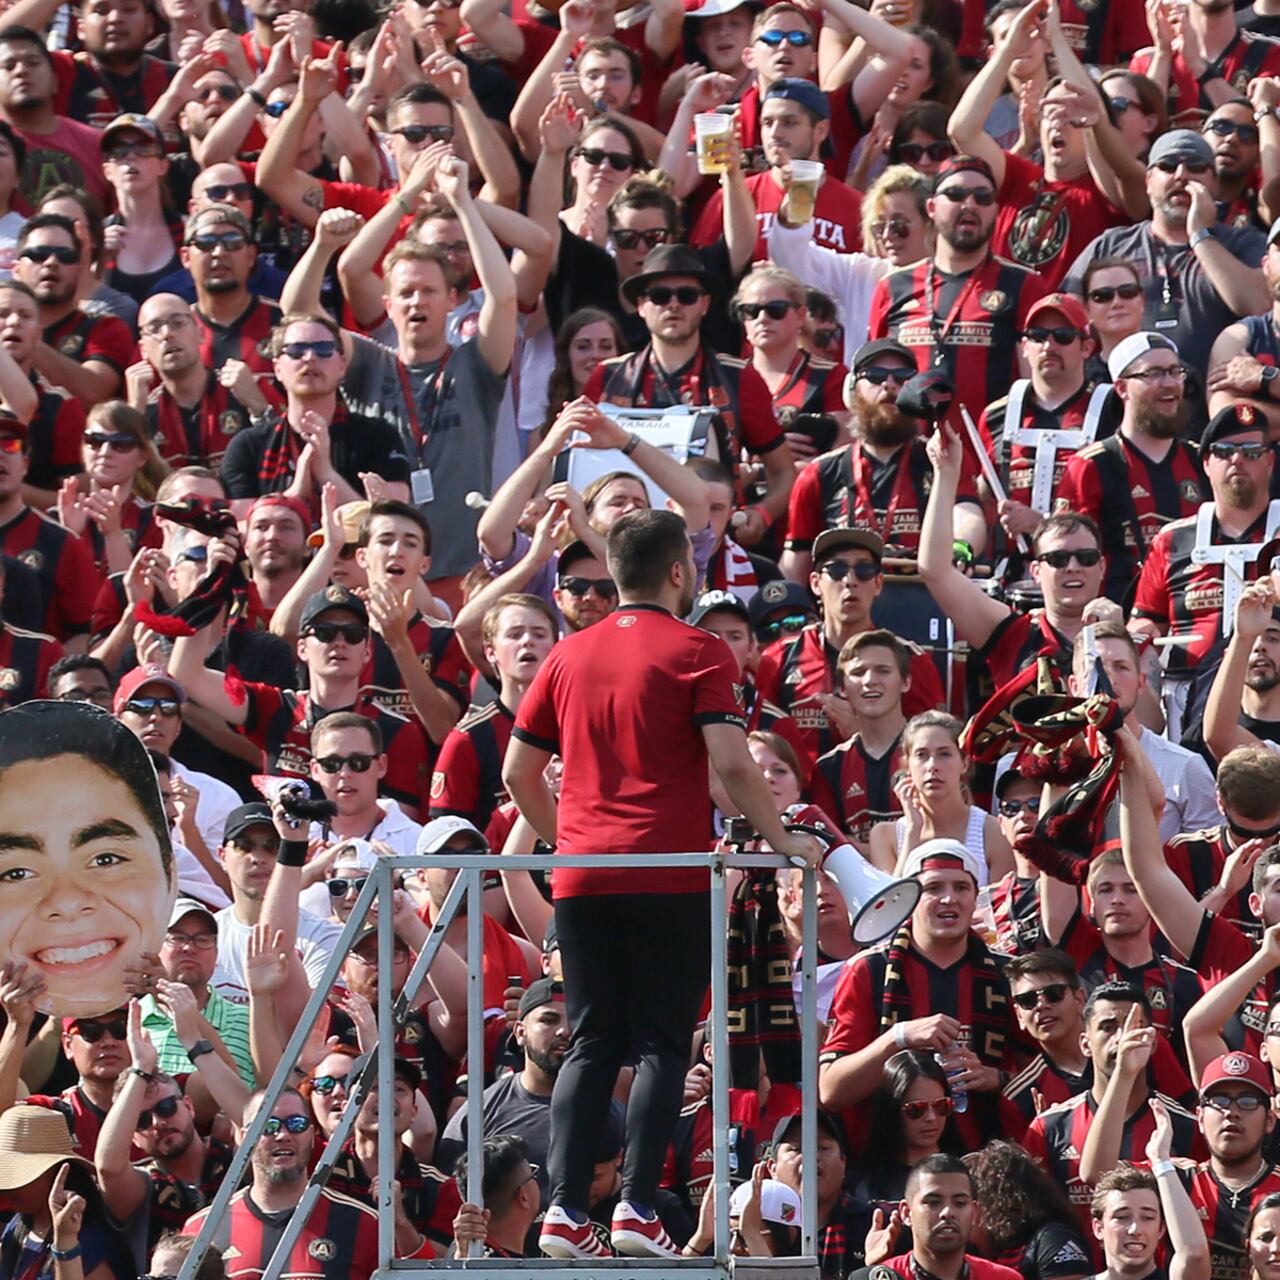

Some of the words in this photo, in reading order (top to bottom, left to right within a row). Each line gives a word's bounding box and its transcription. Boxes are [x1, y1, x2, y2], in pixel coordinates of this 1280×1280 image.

[899, 326, 944, 337] AMERI
[952, 326, 993, 337] FAMILY
[1186, 590, 1223, 599] AMERIC
[791, 709, 827, 717] AMERIC
